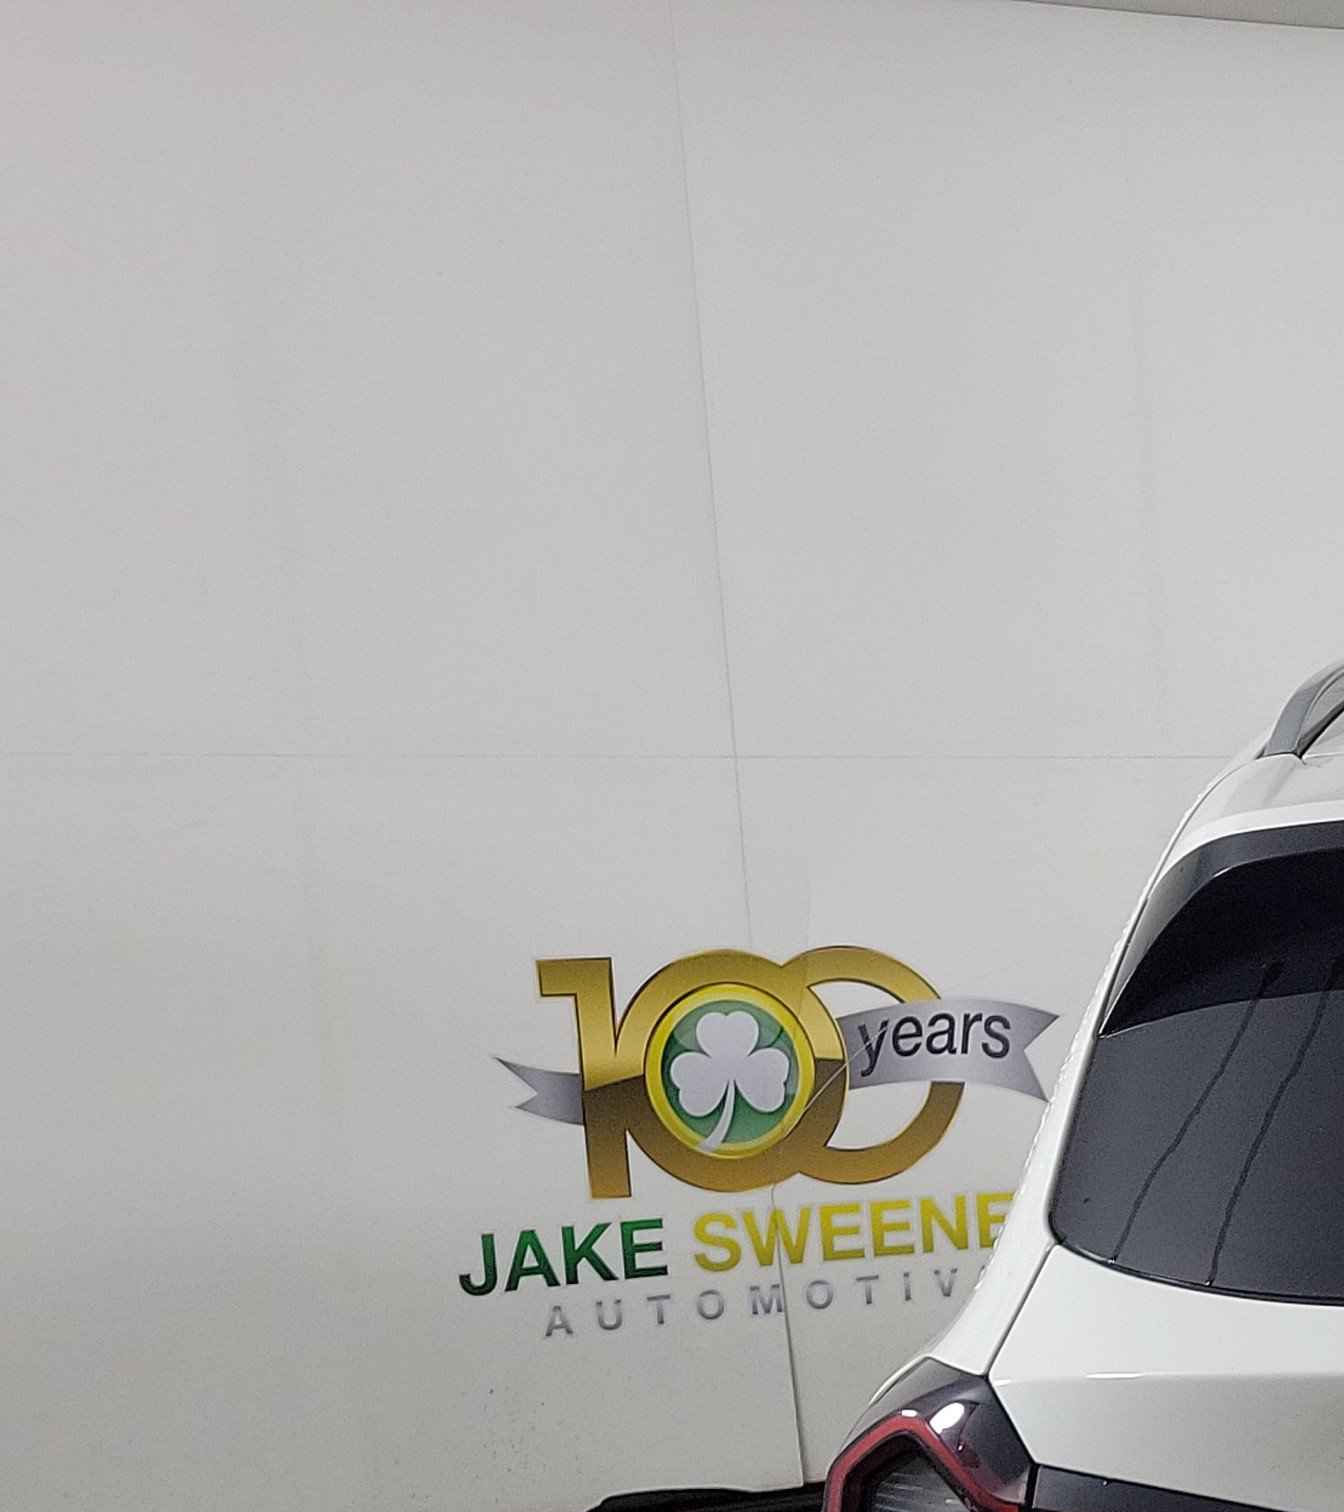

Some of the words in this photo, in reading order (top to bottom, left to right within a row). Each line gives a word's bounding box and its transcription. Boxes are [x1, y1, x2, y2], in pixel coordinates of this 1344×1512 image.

[858, 1010, 1011, 1076] years
[459, 1216, 669, 1297] JAKE
[693, 1190, 1017, 1273] SWEENE
[544, 1265, 985, 1338] AUTOMOTIV
